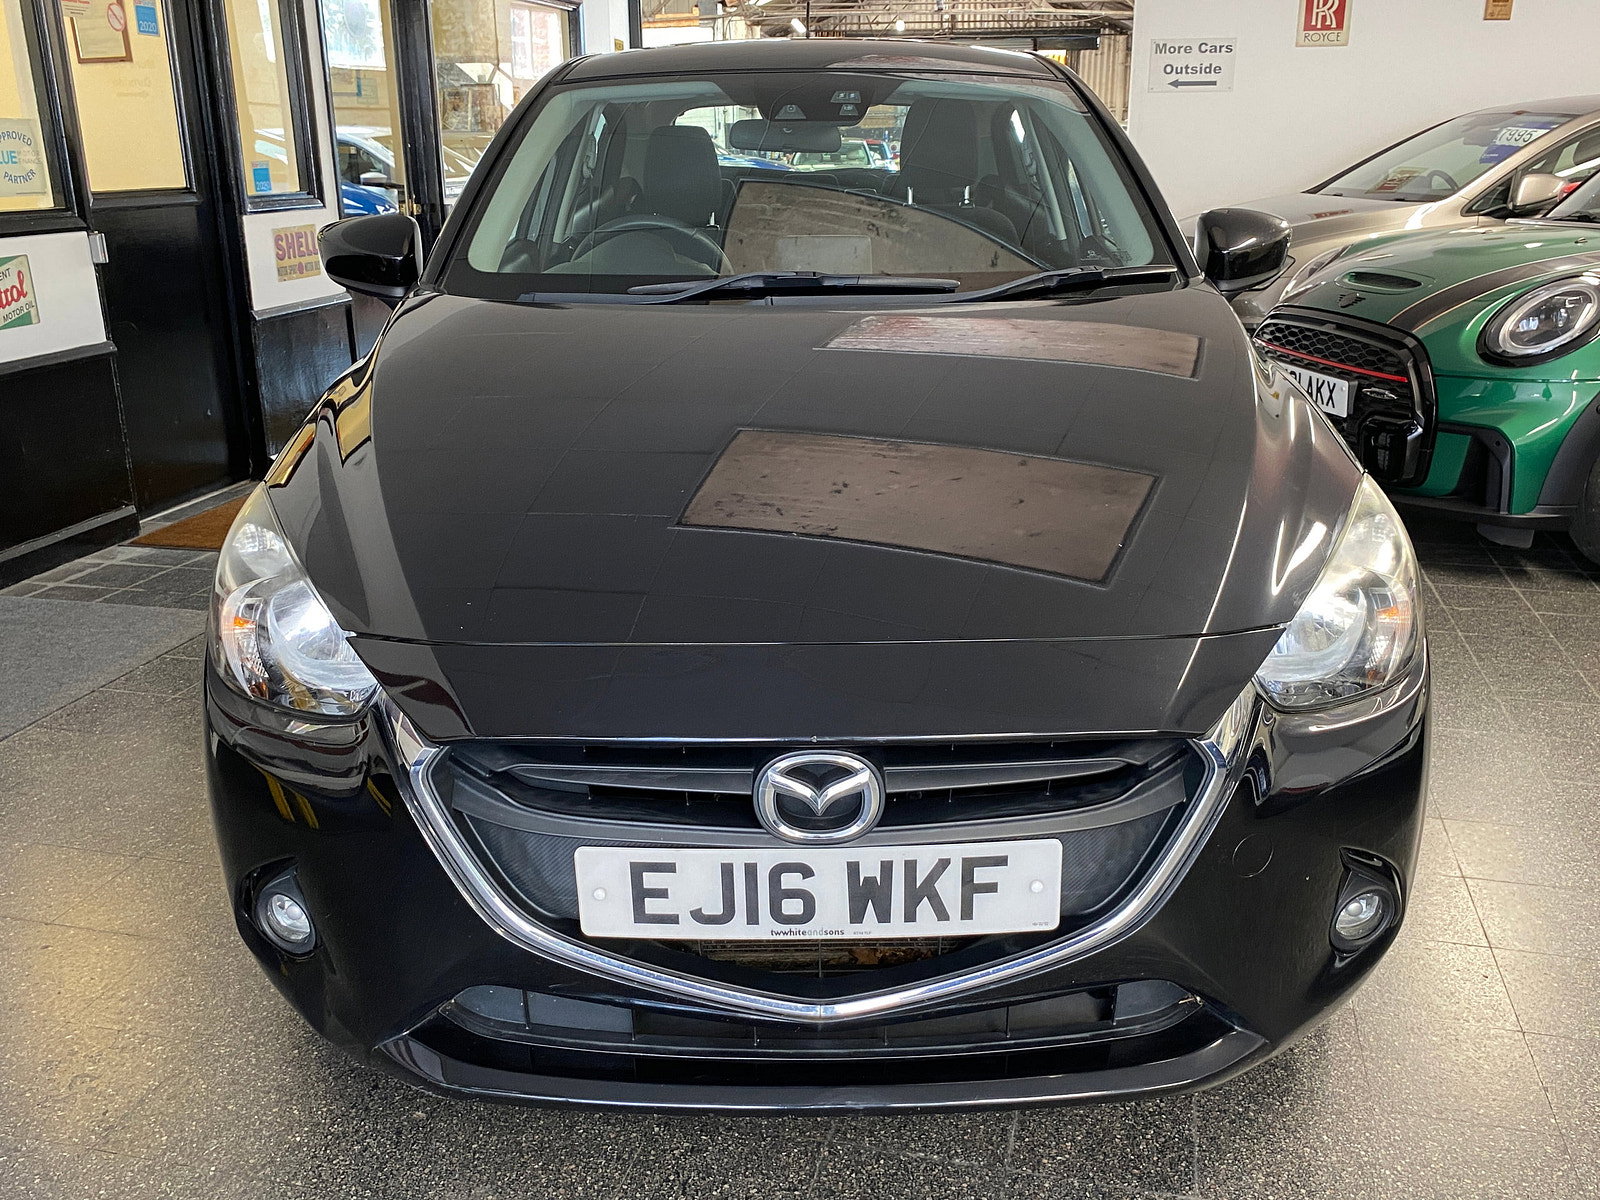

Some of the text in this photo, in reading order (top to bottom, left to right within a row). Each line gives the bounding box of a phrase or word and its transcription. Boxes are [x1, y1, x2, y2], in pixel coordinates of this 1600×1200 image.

[138, 20, 157, 33] 2020
[1303, 32, 1342, 43] ROYCE
[1154, 42, 1234, 55] More Cars
[1163, 62, 1222, 75] Outside
[1499, 128, 1538, 143] 7995
[3, 168, 37, 185] PARTNER
[274, 231, 319, 261] SHELL
[3, 300, 35, 323] MOTOR OIL
[629, 855, 1009, 925] EJ16 WKF
